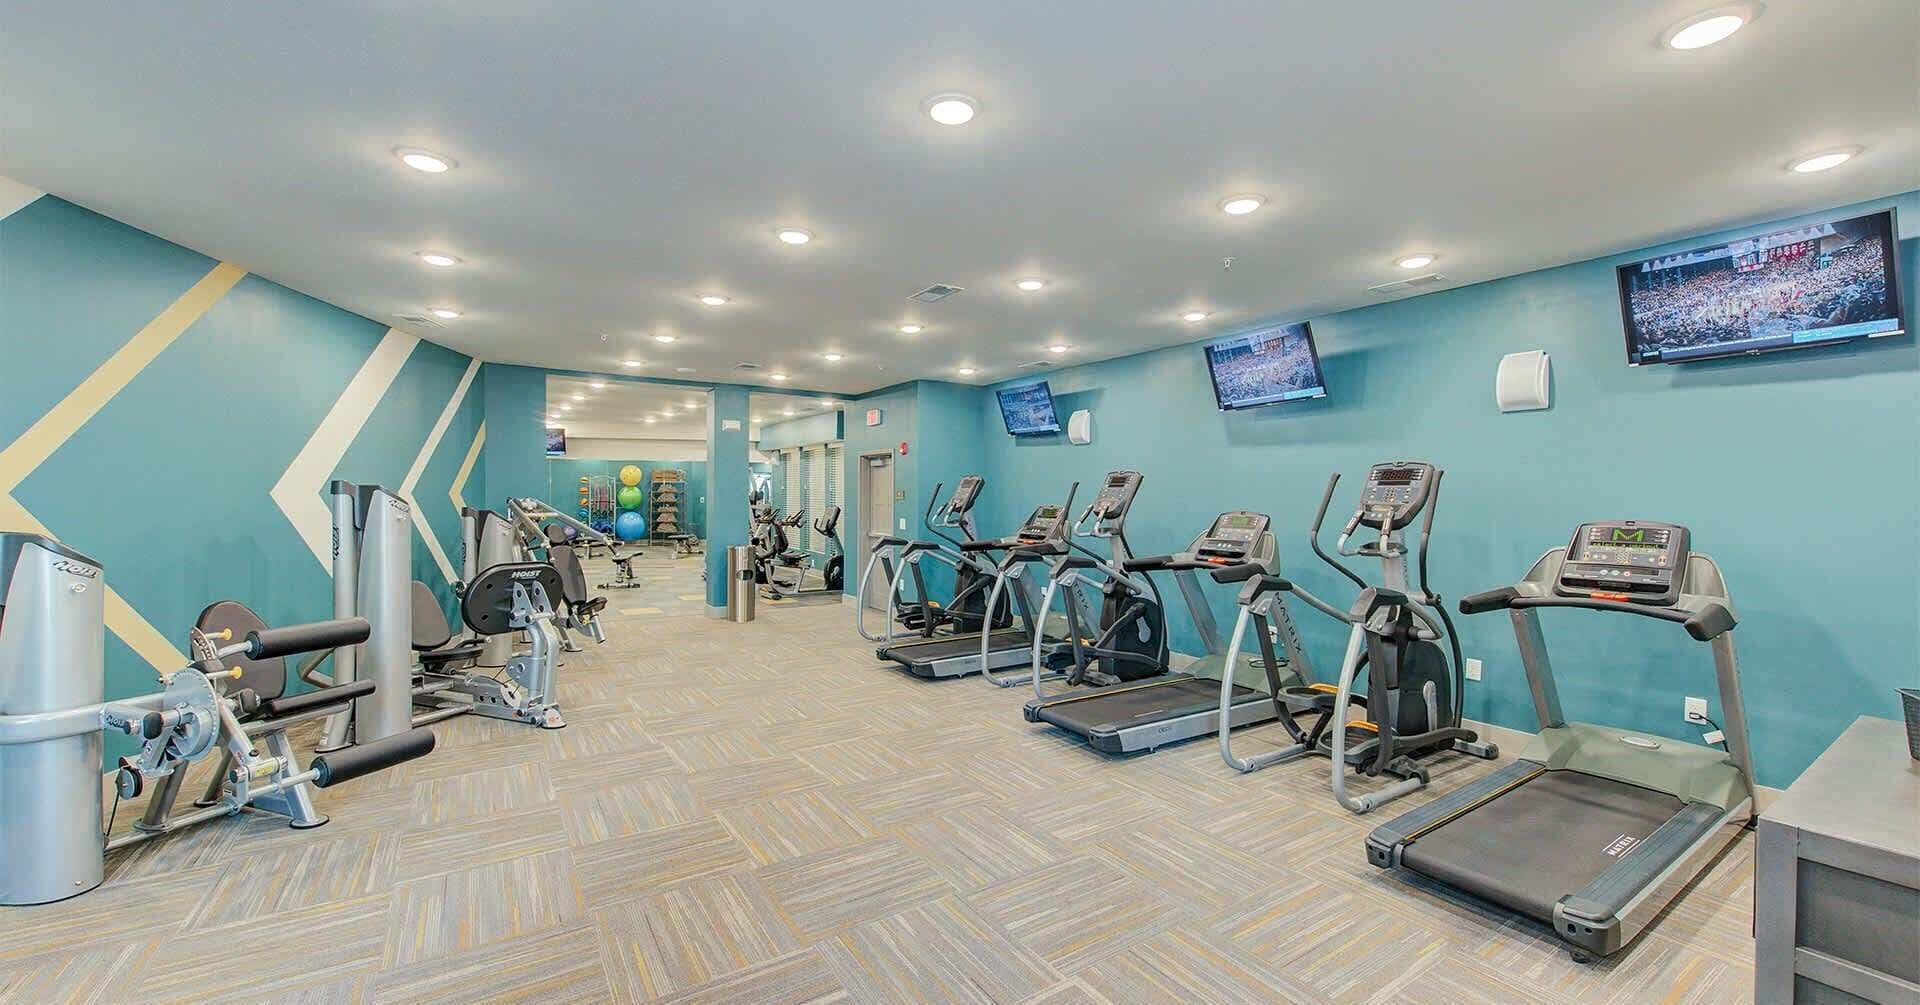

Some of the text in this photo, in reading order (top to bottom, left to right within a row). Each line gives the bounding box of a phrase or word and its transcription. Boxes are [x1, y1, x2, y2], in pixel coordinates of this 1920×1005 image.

[512, 570, 541, 579] HOIST
[1275, 592, 1301, 653] MATRIX
[1607, 836, 1635, 856] MATRIX
